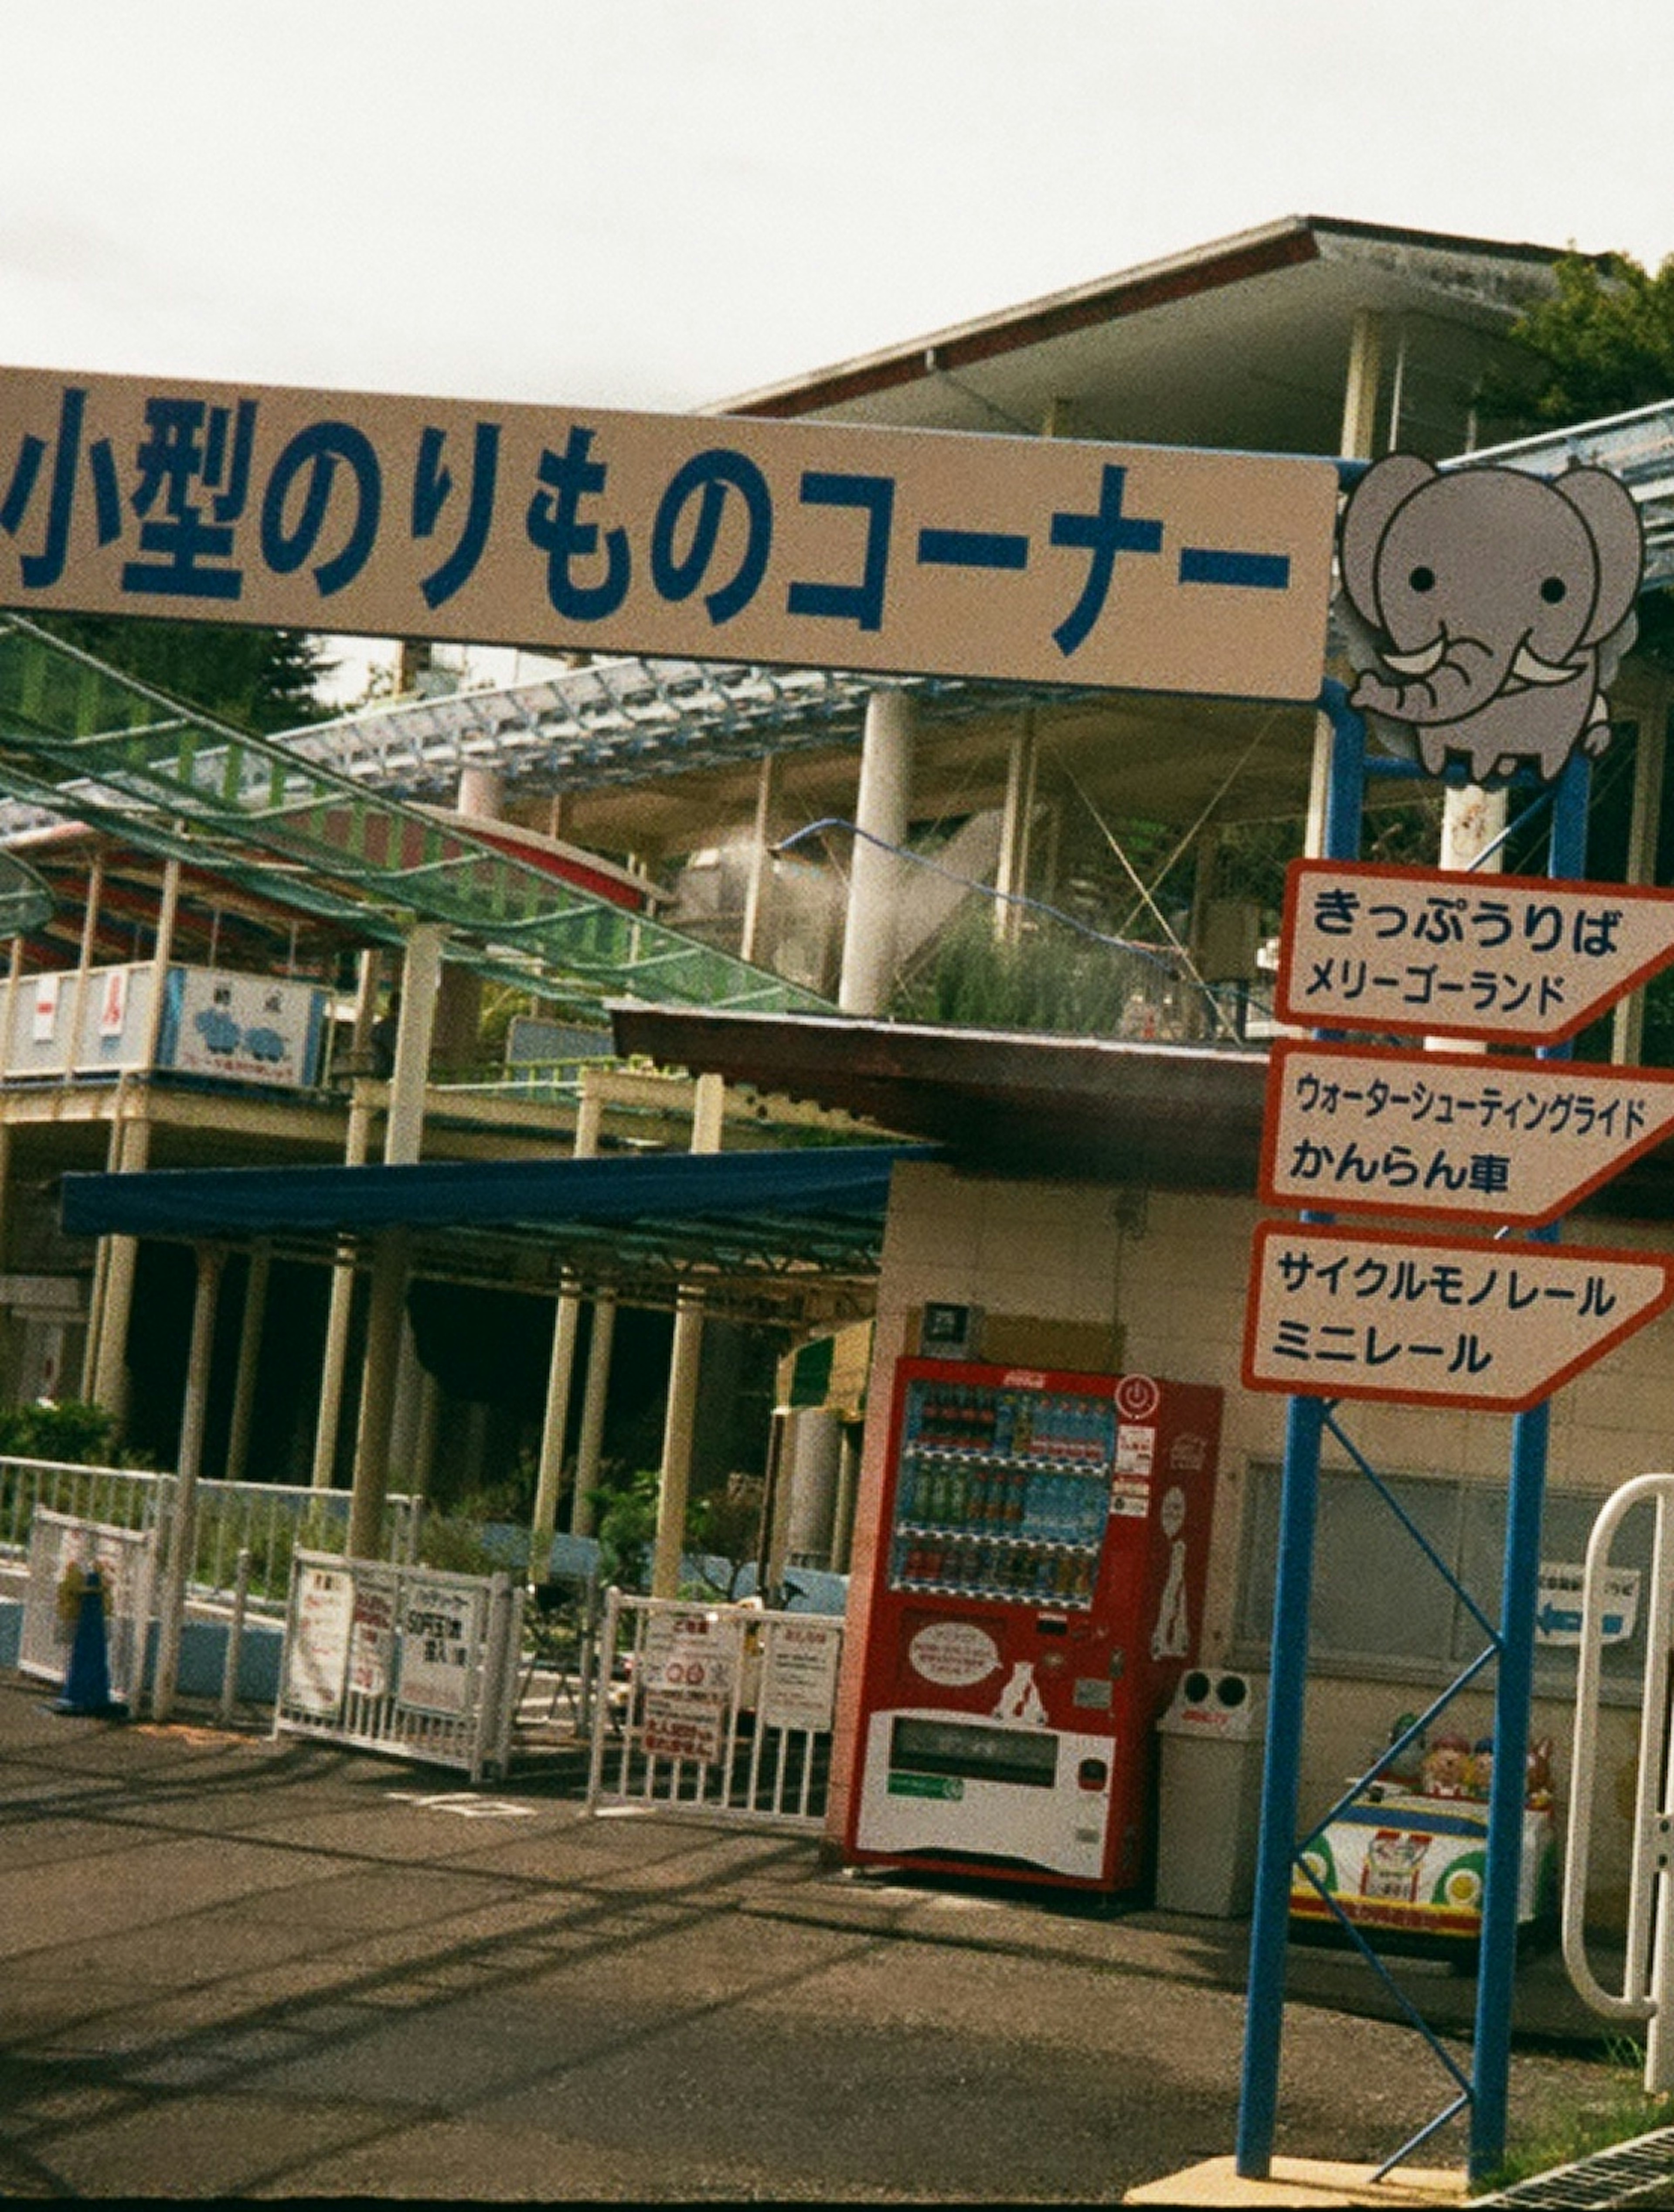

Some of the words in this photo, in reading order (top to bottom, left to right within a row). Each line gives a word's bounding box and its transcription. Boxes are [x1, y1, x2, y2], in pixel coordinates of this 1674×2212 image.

[0, 388, 1290, 656] 小型のりものコーナー
[1314, 888, 1623, 957] きっぷうりば
[1306, 958, 1565, 1015] メリーゴーランド
[1296, 1073, 1645, 1139] ウォーターシューティングライド
[1290, 1139, 1510, 1194] かんらん車
[1278, 1251, 1616, 1316] サイクルモノレール
[1272, 1320, 1492, 1374] ミニレール
